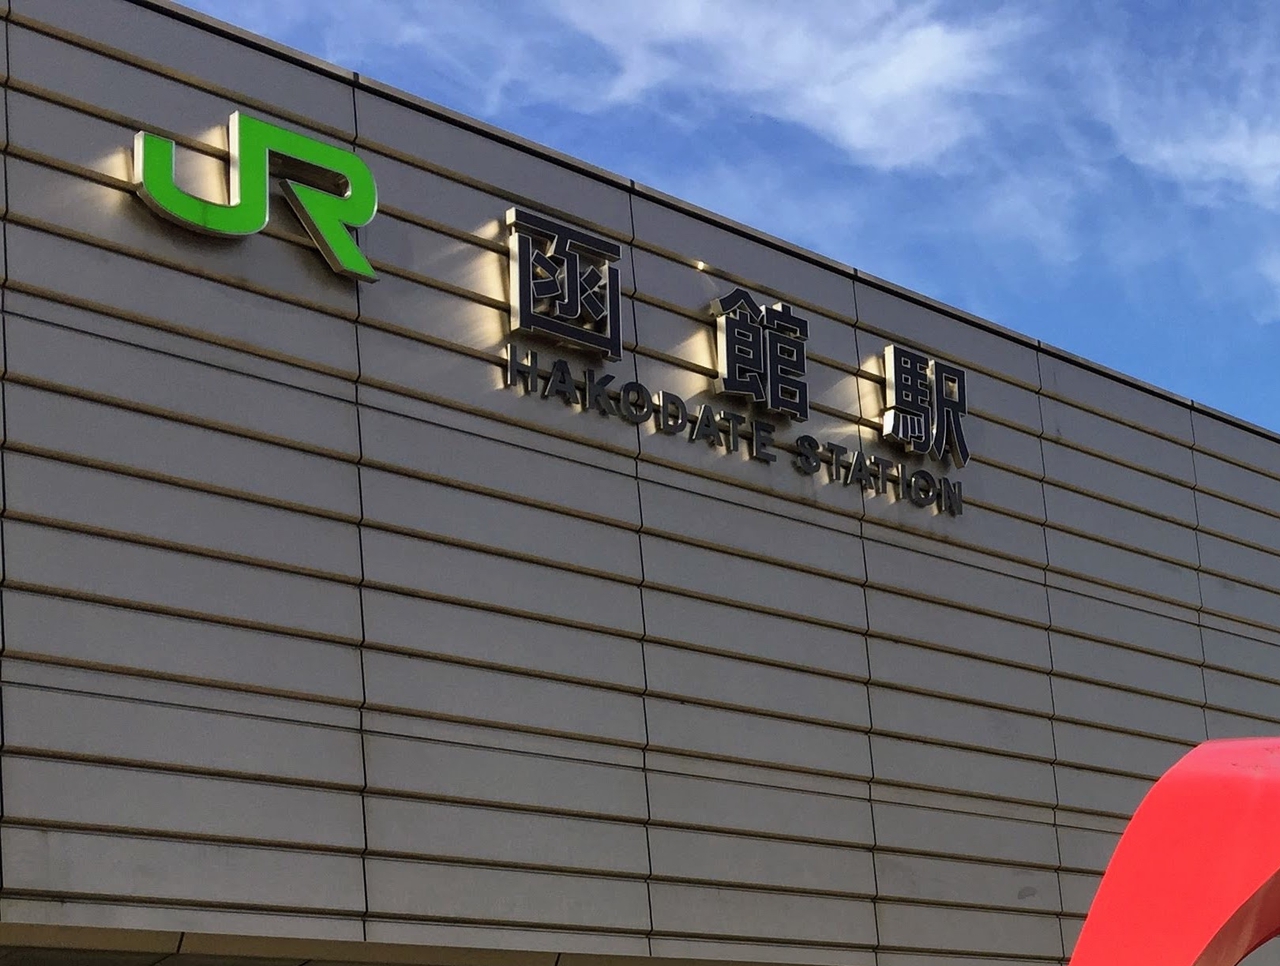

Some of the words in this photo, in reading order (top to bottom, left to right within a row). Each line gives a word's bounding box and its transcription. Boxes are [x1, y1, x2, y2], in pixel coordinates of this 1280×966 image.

[134, 110, 379, 283] JR
[506, 207, 971, 468] 函館駅
[507, 343, 777, 462] HAKODATE
[795, 434, 963, 516] STATION
